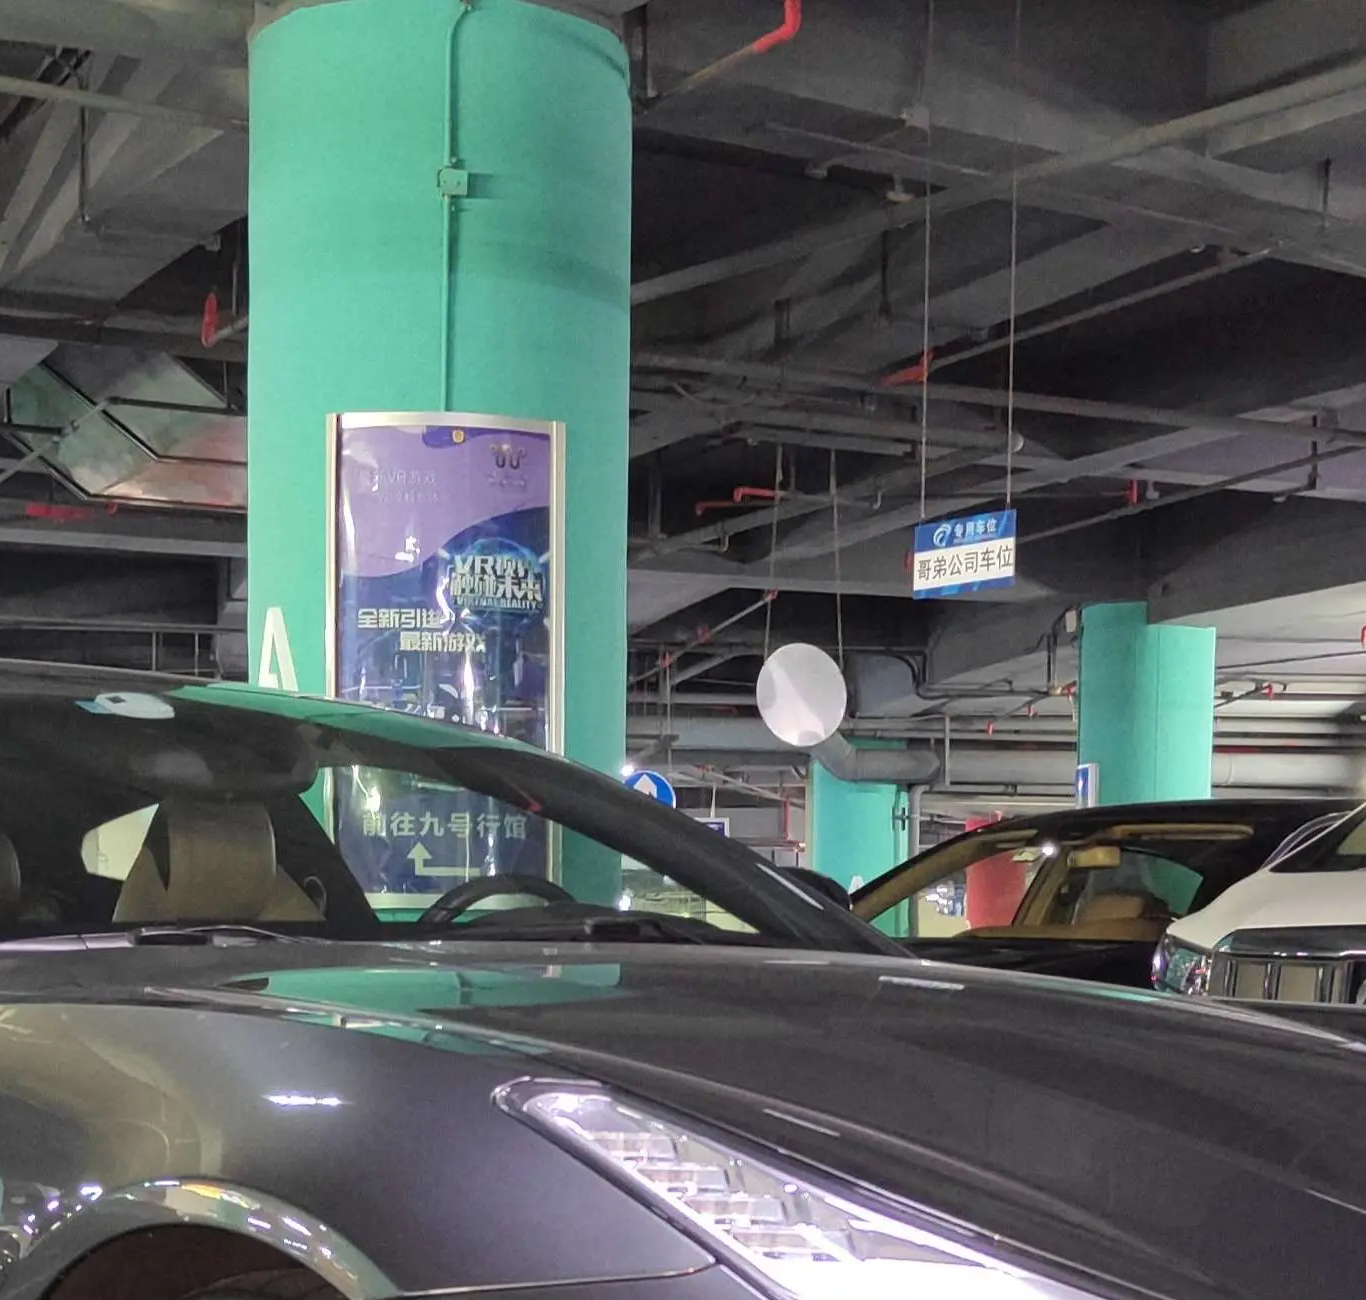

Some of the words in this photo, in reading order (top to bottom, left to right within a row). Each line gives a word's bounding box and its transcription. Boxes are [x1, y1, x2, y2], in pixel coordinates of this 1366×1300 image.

[954, 518, 998, 538] 专用车位
[917, 543, 1014, 581] 哥弟公司车位
[357, 608, 446, 629] 全新引进
[258, 606, 299, 692] A
[399, 631, 487, 653] 最新游戏
[362, 810, 528, 840] 前往九号行馆
